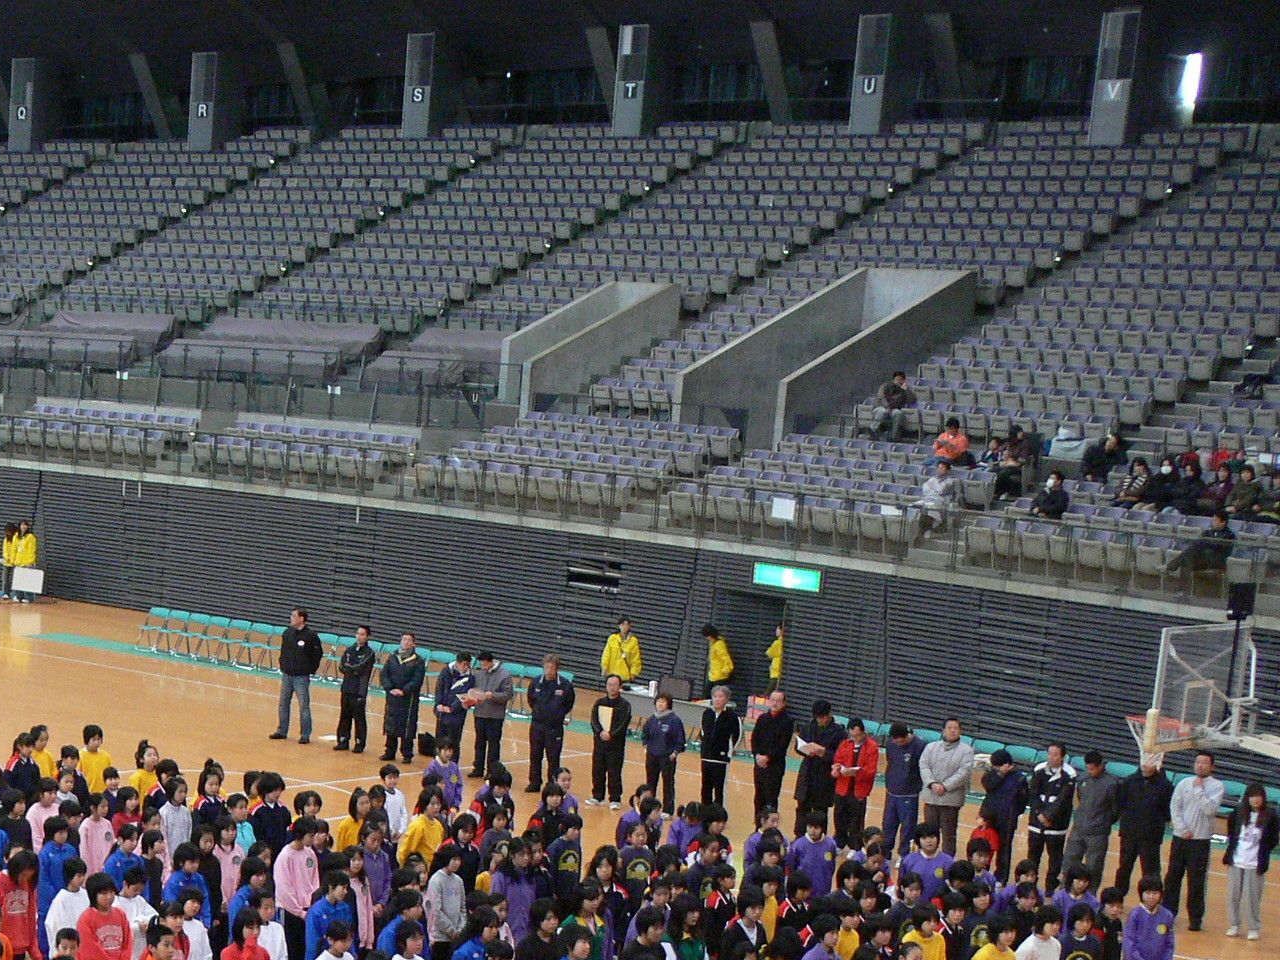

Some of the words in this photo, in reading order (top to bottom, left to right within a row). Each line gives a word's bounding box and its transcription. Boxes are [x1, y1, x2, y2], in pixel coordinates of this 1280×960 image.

[625, 82, 636, 98] T
[863, 78, 876, 94] U
[1108, 81, 1120, 100] V
[412, 87, 423, 102] S
[17, 106, 27, 120] Q
[197, 104, 207, 117] R
